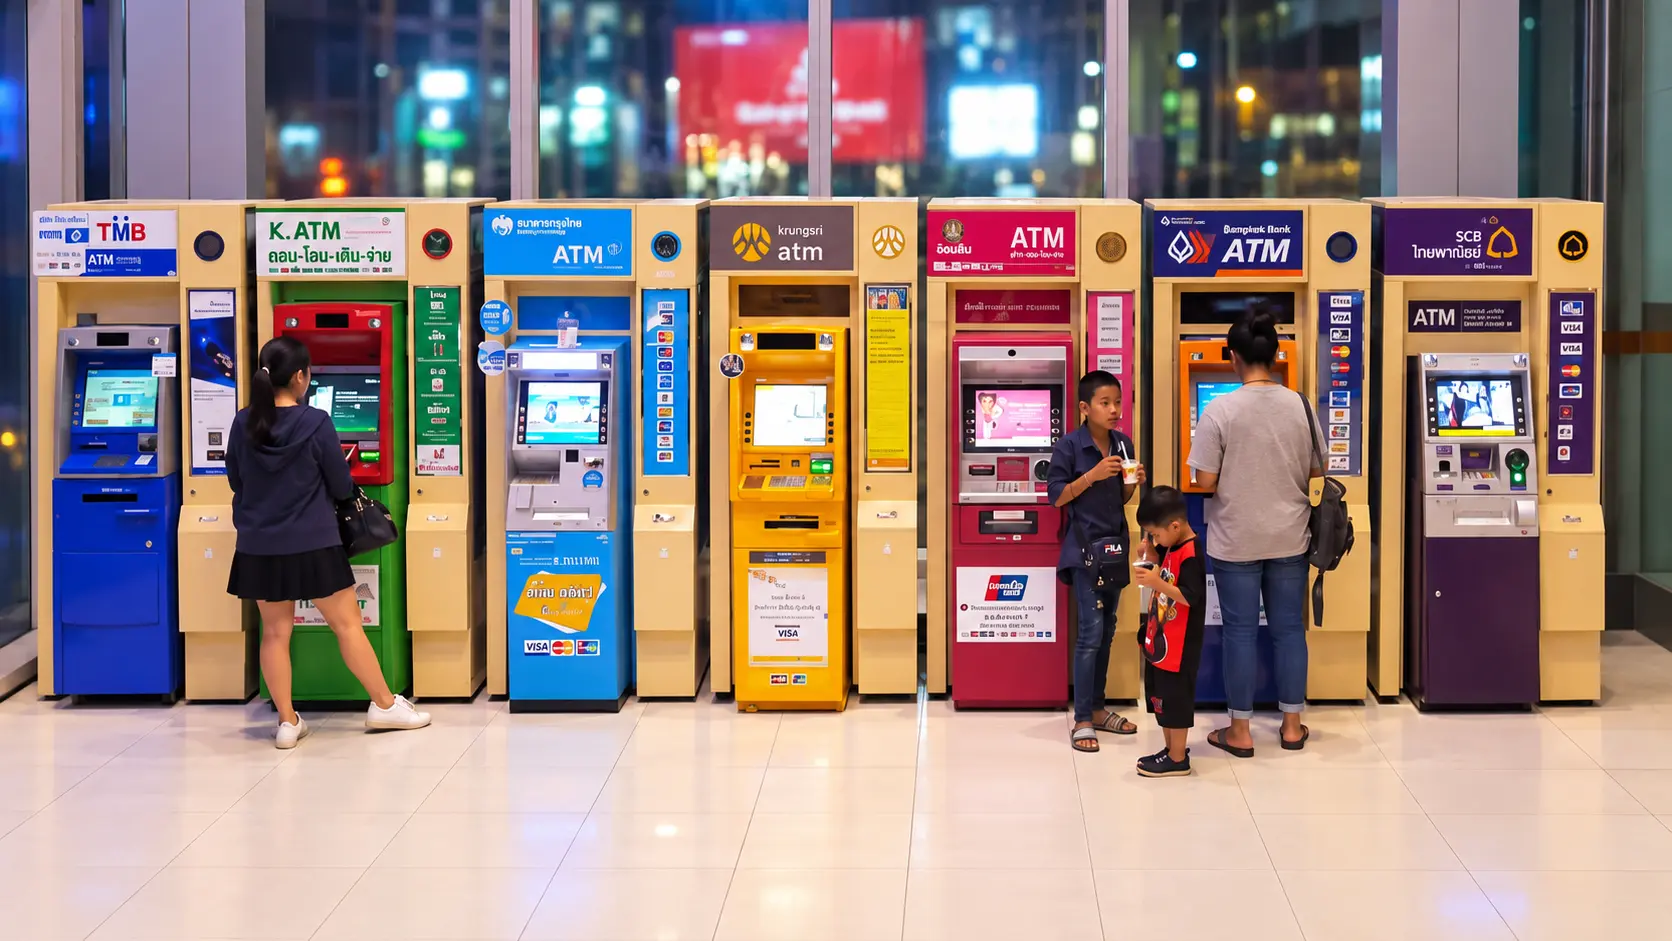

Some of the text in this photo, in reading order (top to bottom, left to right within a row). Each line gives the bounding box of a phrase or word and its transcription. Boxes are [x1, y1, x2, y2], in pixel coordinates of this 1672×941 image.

[97, 216, 146, 241] TMB
[778, 225, 823, 238] krungsri
[1010, 227, 1064, 249] ATM
[1456, 231, 1482, 242] SCB
[553, 245, 603, 264] ATM
[778, 243, 823, 261] atm
[1221, 239, 1291, 263] ATM
[88, 254, 114, 265] ATM
[1413, 308, 1455, 326] ATM
[1104, 544, 1122, 553] FILA
[778, 629, 798, 638] VISA
[526, 642, 549, 651] VISA
